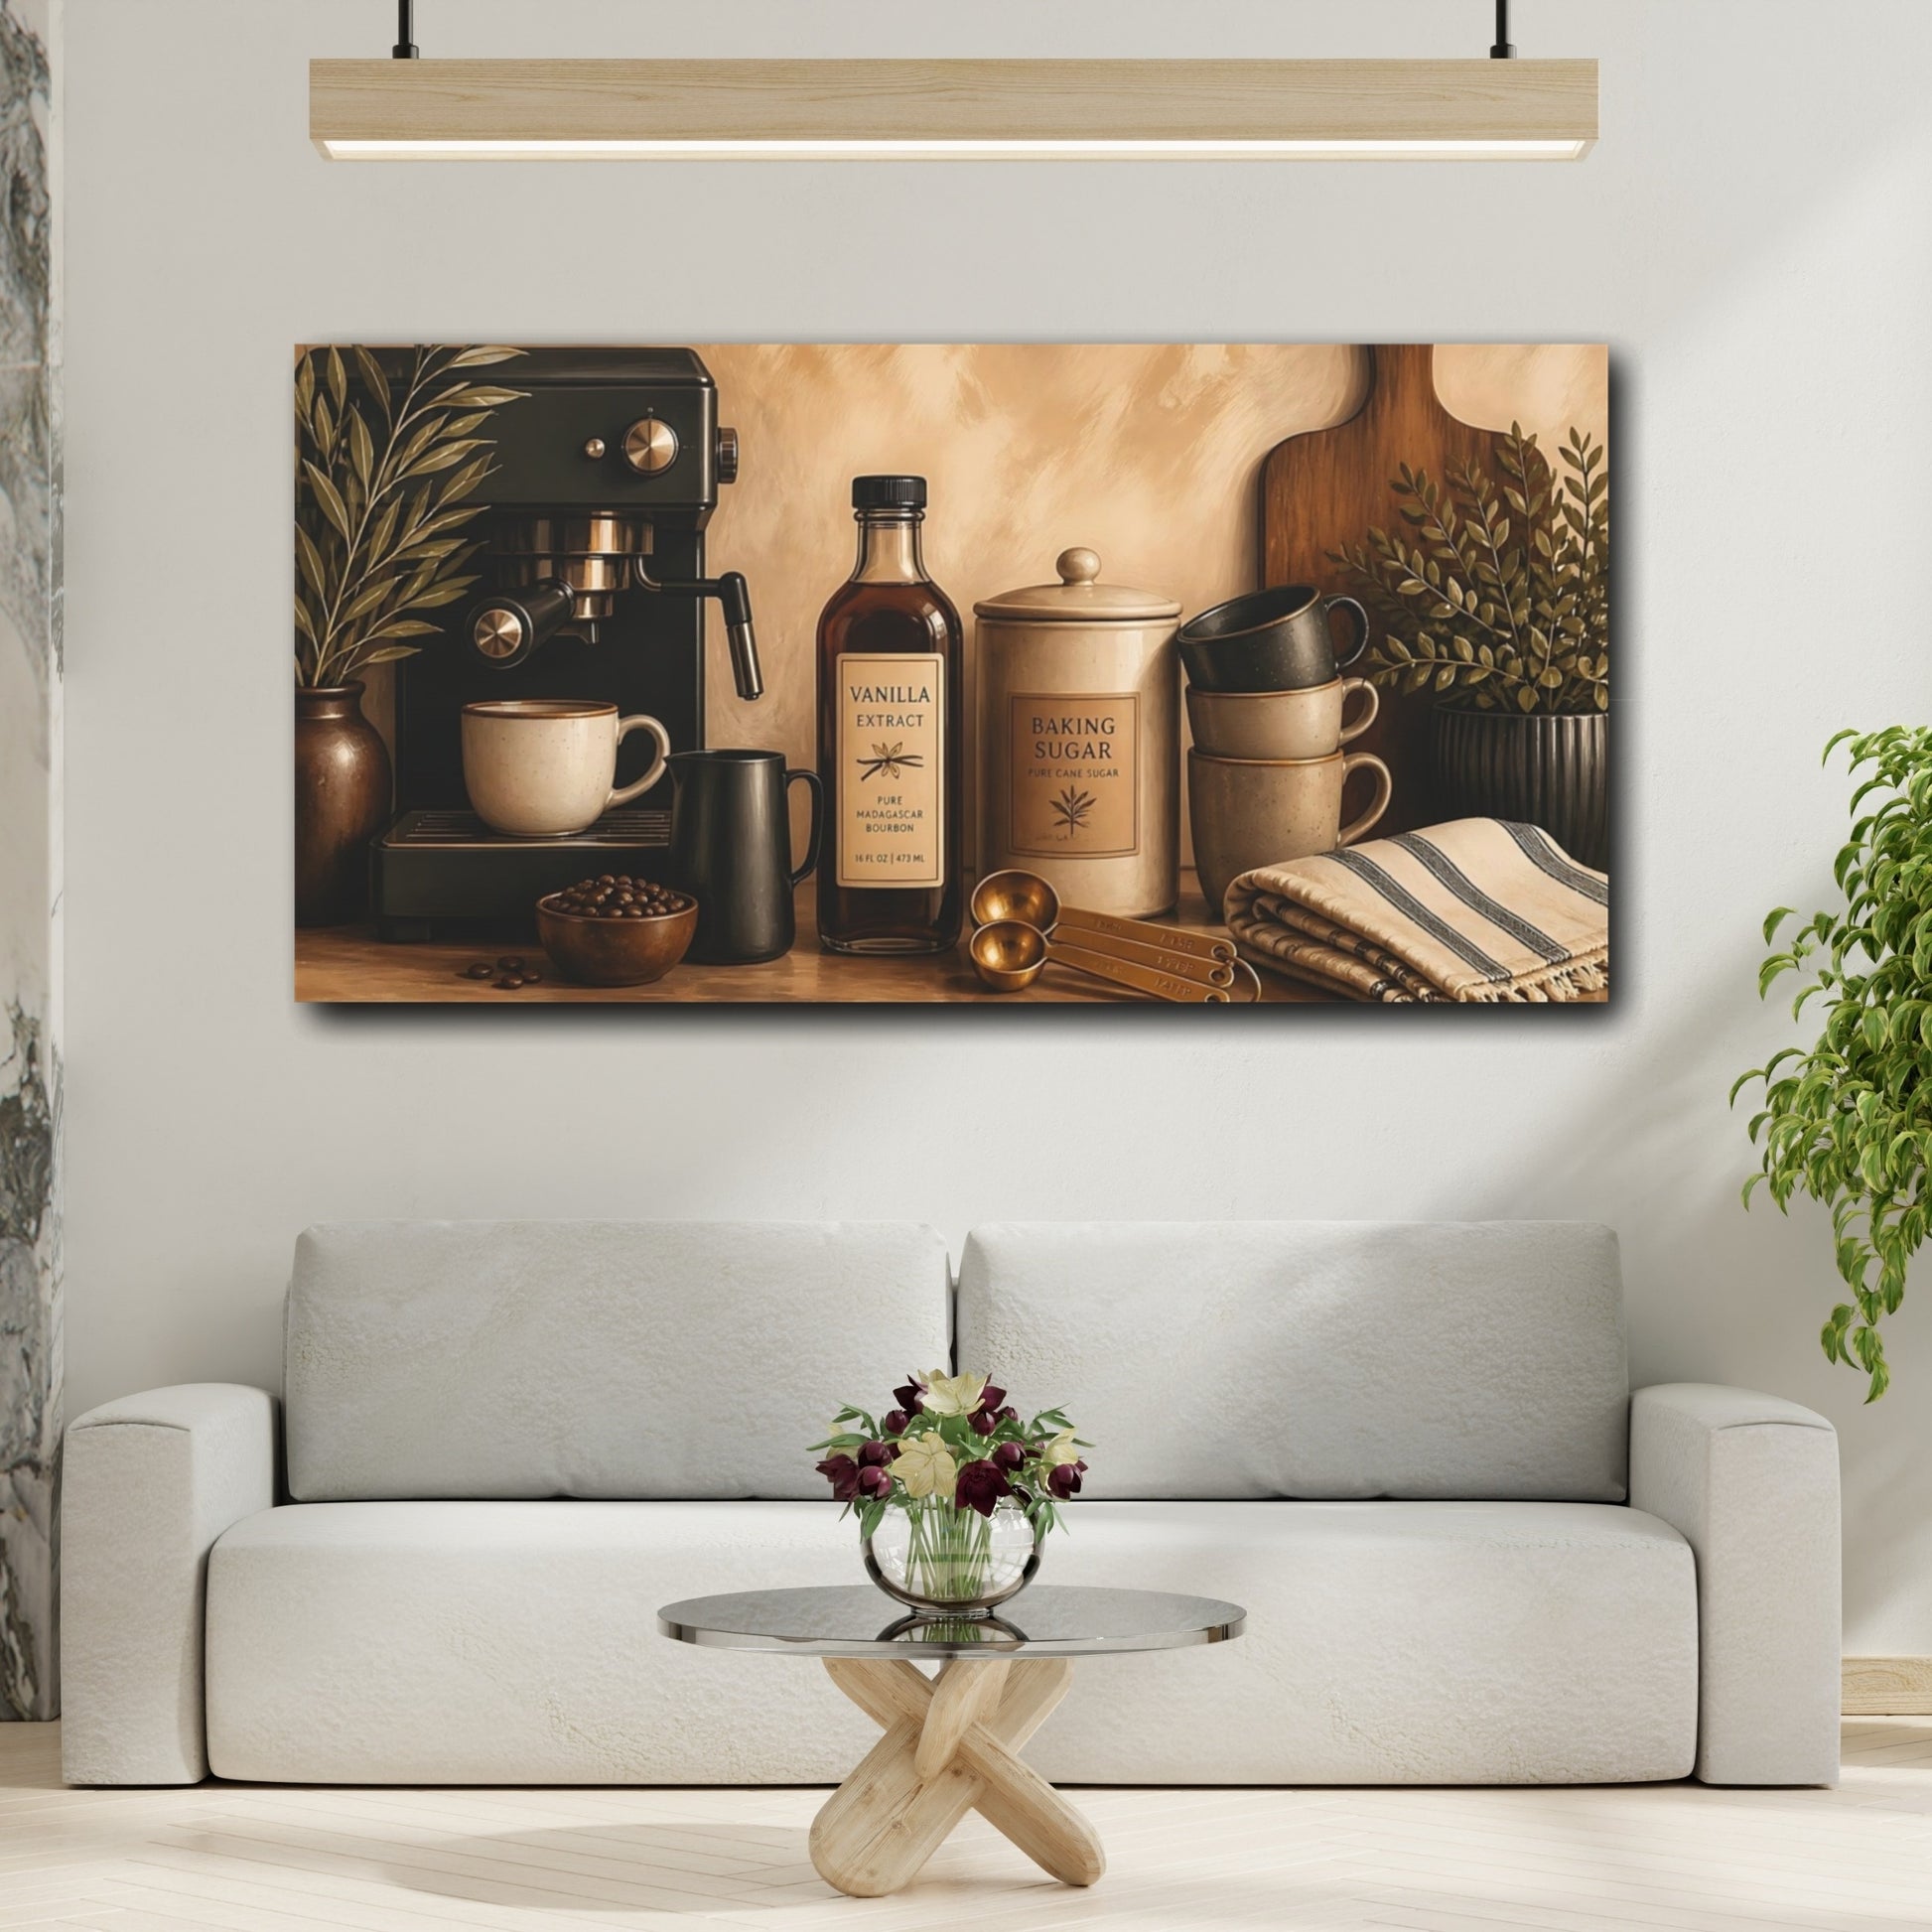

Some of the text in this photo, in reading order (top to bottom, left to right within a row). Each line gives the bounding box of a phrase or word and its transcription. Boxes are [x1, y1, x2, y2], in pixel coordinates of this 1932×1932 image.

[850, 686, 930, 703] VANILLA
[857, 714, 924, 728] EXTRACT
[1033, 717, 1115, 735] BAKING
[1035, 741, 1112, 759] SUGAR
[1029, 768, 1119, 778] PURE CANE SUGAR
[877, 795, 902, 805] PURE
[856, 809, 923, 819] MADAGASCAR
[866, 823, 914, 833] BOURBON
[855, 854, 864, 863] 16
[866, 854, 874, 863] FL
[877, 854, 889, 863] OZ
[896, 854, 911, 863] 473
[913, 854, 925, 863] ML
